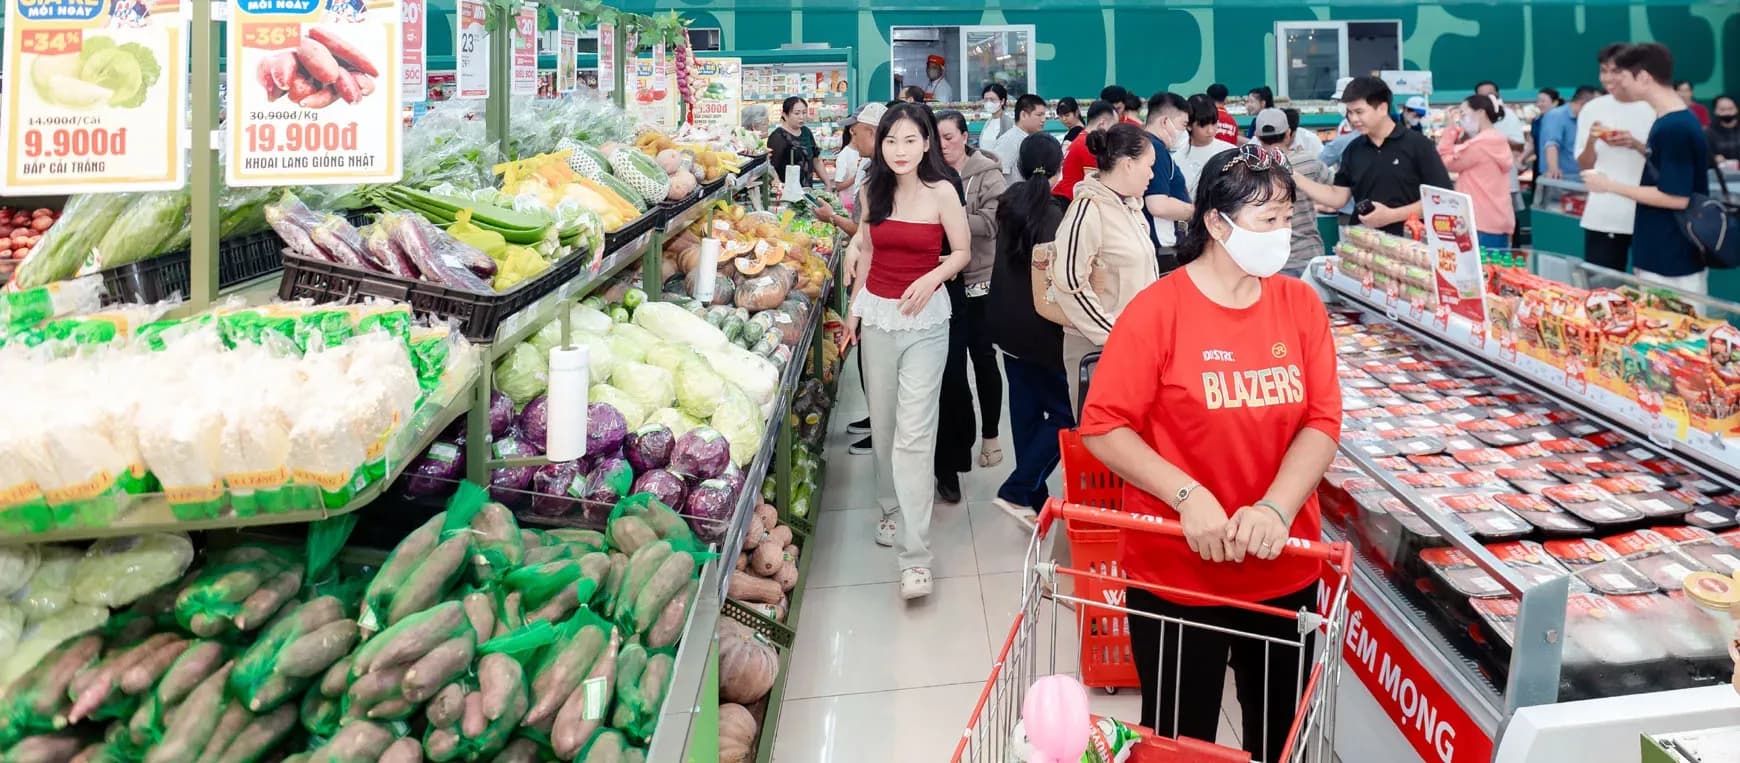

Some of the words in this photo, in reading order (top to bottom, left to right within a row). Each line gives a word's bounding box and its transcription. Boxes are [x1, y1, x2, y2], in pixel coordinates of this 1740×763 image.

[23, 32, 80, 51] -34%
[245, 26, 299, 46] -36%
[462, 32, 474, 53] 23
[249, 110, 319, 121] 30.900đ/Kg
[25, 127, 127, 158] 9.900đ
[245, 121, 358, 152] 19.900đ
[245, 157, 278, 169] KHOAI
[282, 156, 309, 168] LANG
[1202, 364, 1304, 410] BLAZERS
[1378, 652, 1456, 763] MỌNG
